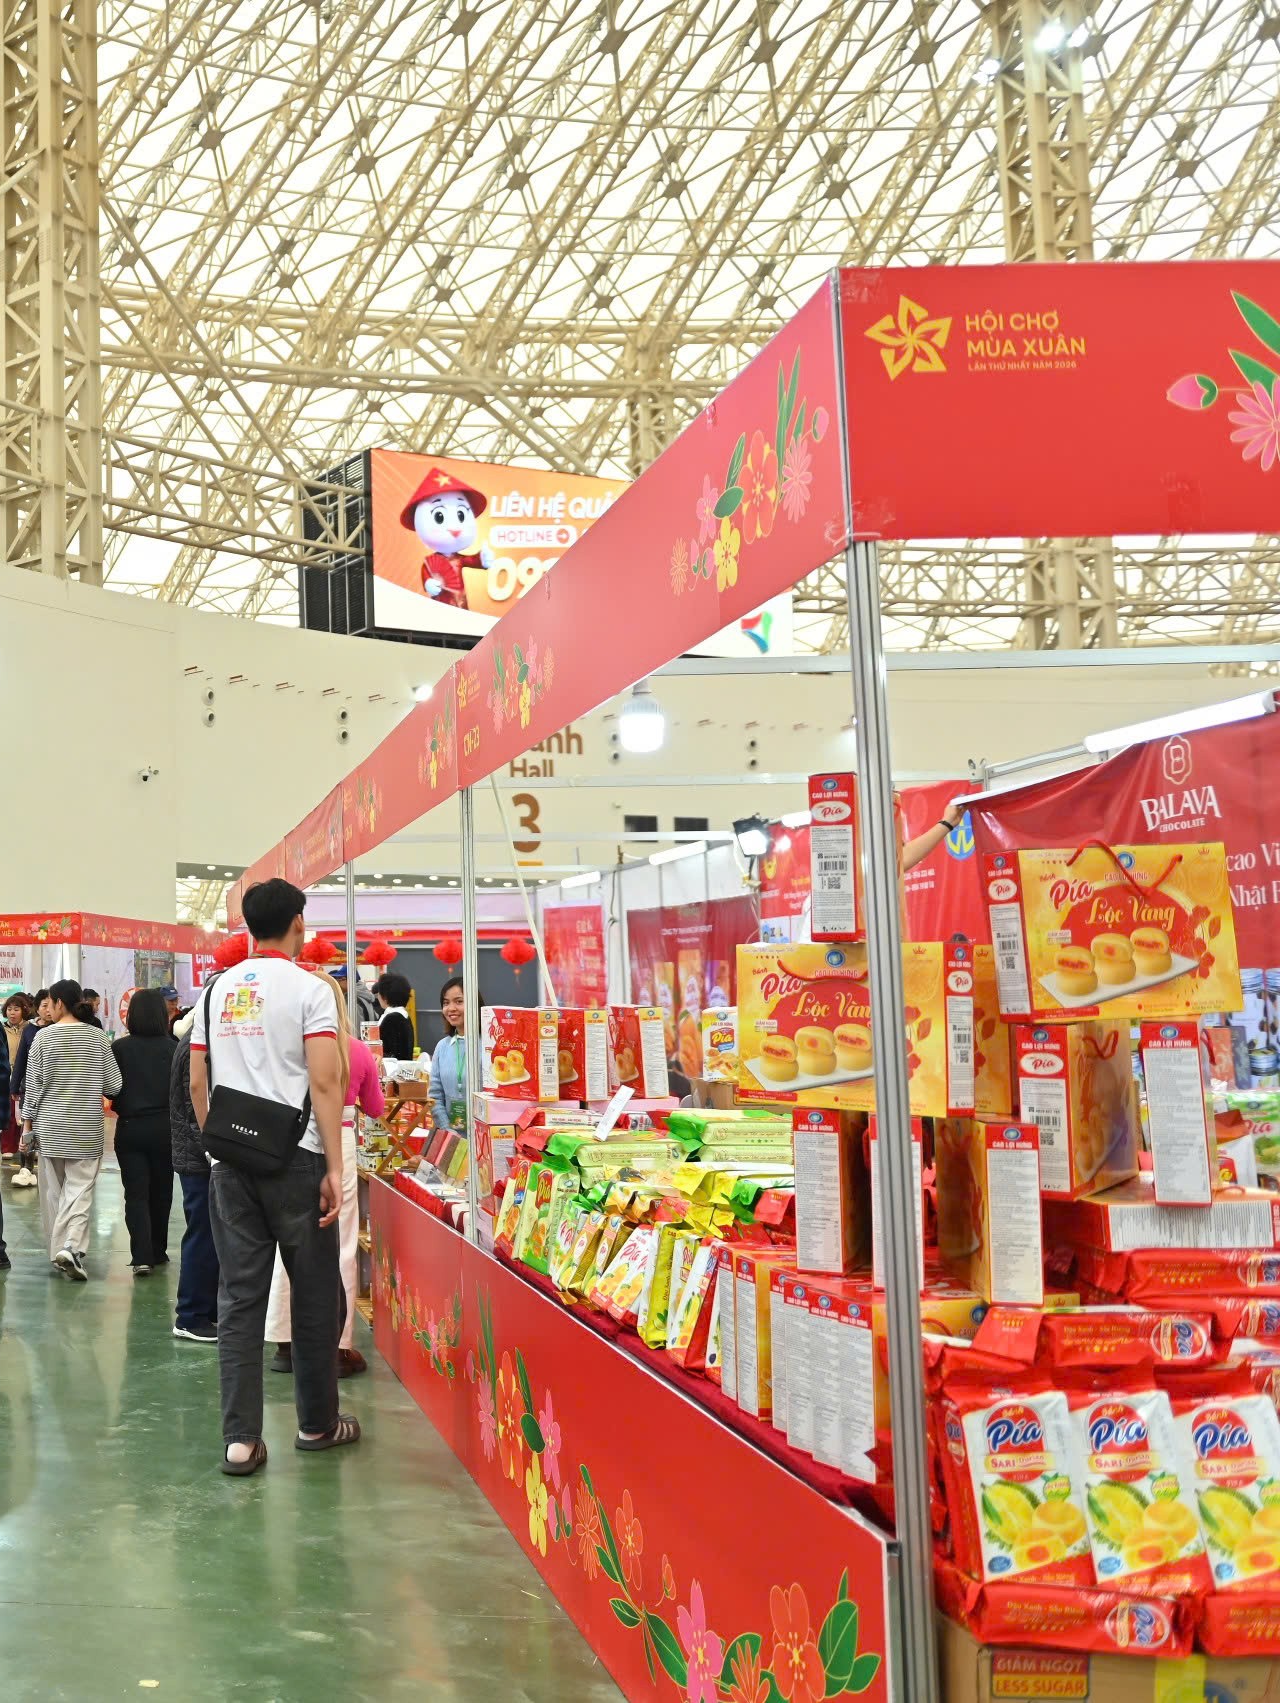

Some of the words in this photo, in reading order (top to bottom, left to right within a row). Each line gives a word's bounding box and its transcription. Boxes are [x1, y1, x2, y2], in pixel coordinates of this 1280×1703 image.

[965, 309, 1004, 334] HỘI
[1009, 309, 1060, 333] CHỢ
[967, 334, 1017, 358] MÙA
[1023, 332, 1087, 356] XUÂN
[1054, 360, 1077, 369] 2026
[490, 490, 535, 518] LIÊN
[537, 491, 566, 524] HỆ
[498, 530, 553, 542] HOTLINE
[510, 759, 554, 777] Hall
[1140, 785, 1222, 832] BALAVA
[512, 793, 541, 853] 3
[1160, 817, 1206, 833] CHOCOLATE
[1226, 851, 1256, 872] cao
[1049, 877, 1094, 912] Pía
[1085, 896, 1123, 928] Lộc
[1128, 894, 1176, 931] Vàng
[760, 971, 803, 1003] Pía
[792, 991, 830, 1022] Lộc
[835, 991, 871, 1018] Vàn
[1149, 1040, 1162, 1048] CAO
[993, 1141, 1004, 1149] CAO
[986, 1417, 1043, 1453] Pía
[1089, 1417, 1148, 1453] Pía
[1194, 1423, 1251, 1459] Pía
[991, 1457, 1016, 1469] SARI
[1095, 1458, 1122, 1469] SARI
[1201, 1461, 1228, 1475] SARI
[996, 1656, 1037, 1673] GIẢM
[1039, 1657, 1084, 1675] NGỌT
[995, 1678, 1035, 1693] LESS
[1038, 1678, 1085, 1694] SUGAR
